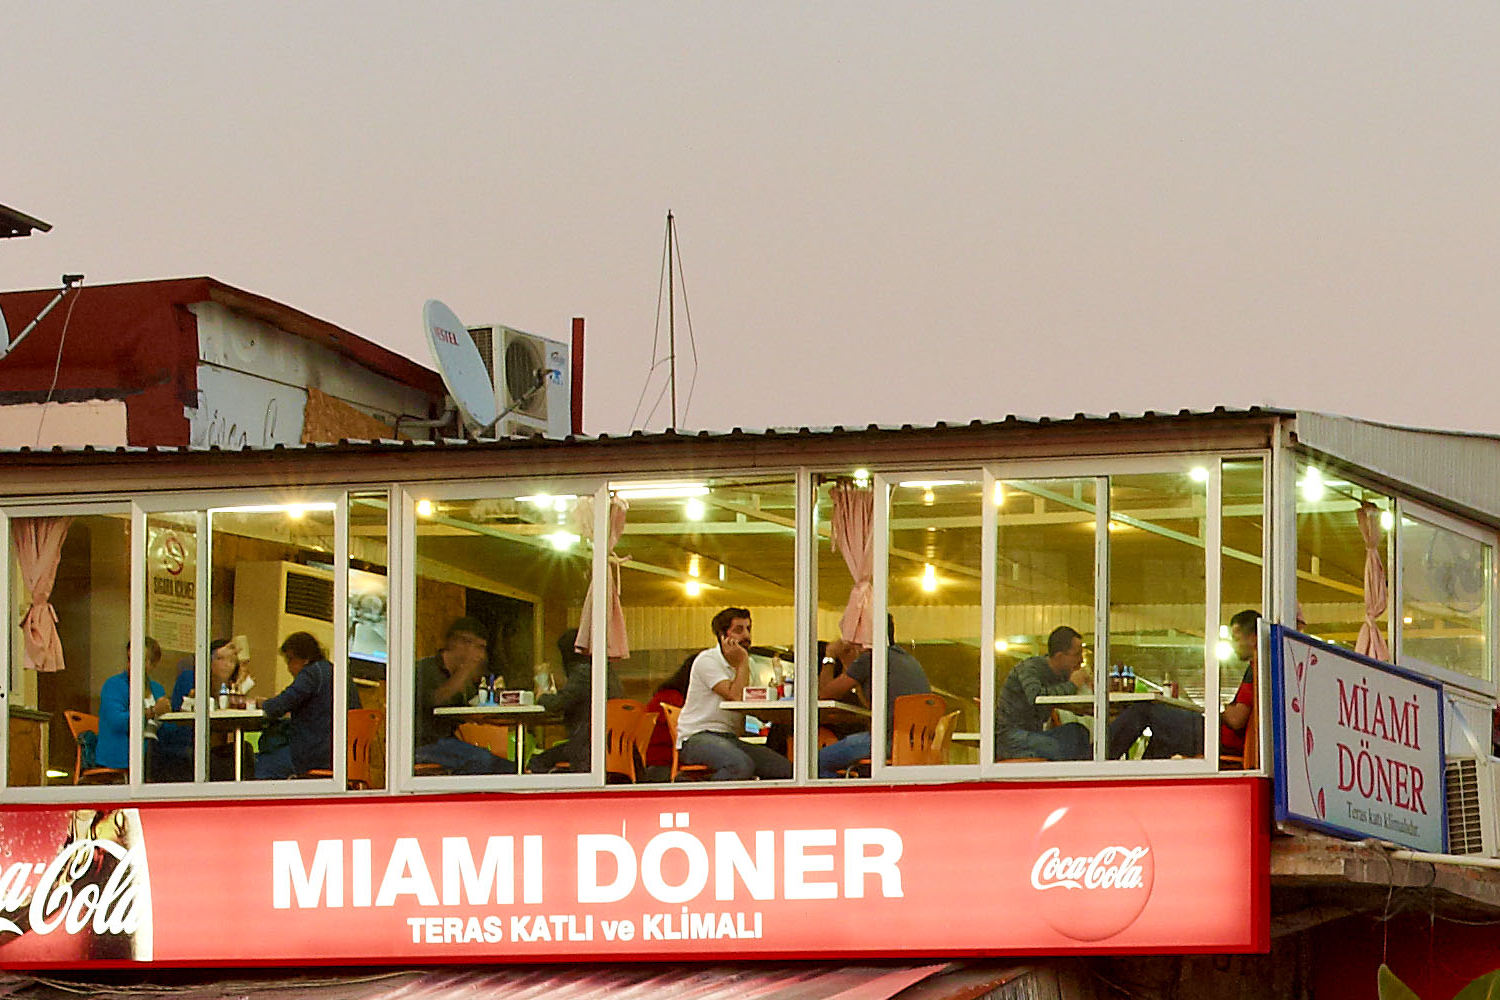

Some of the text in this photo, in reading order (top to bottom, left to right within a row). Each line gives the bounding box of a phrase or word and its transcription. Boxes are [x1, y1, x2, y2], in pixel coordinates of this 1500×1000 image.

[1336, 677, 1421, 750] MİAMİ
[1336, 739, 1427, 815] DÖNER
[273, 812, 904, 909] MIAMI DÖNER
[1031, 846, 1150, 891] Coca-Cola
[407, 906, 763, 943] TERAS KATLI ve KLİMALI
